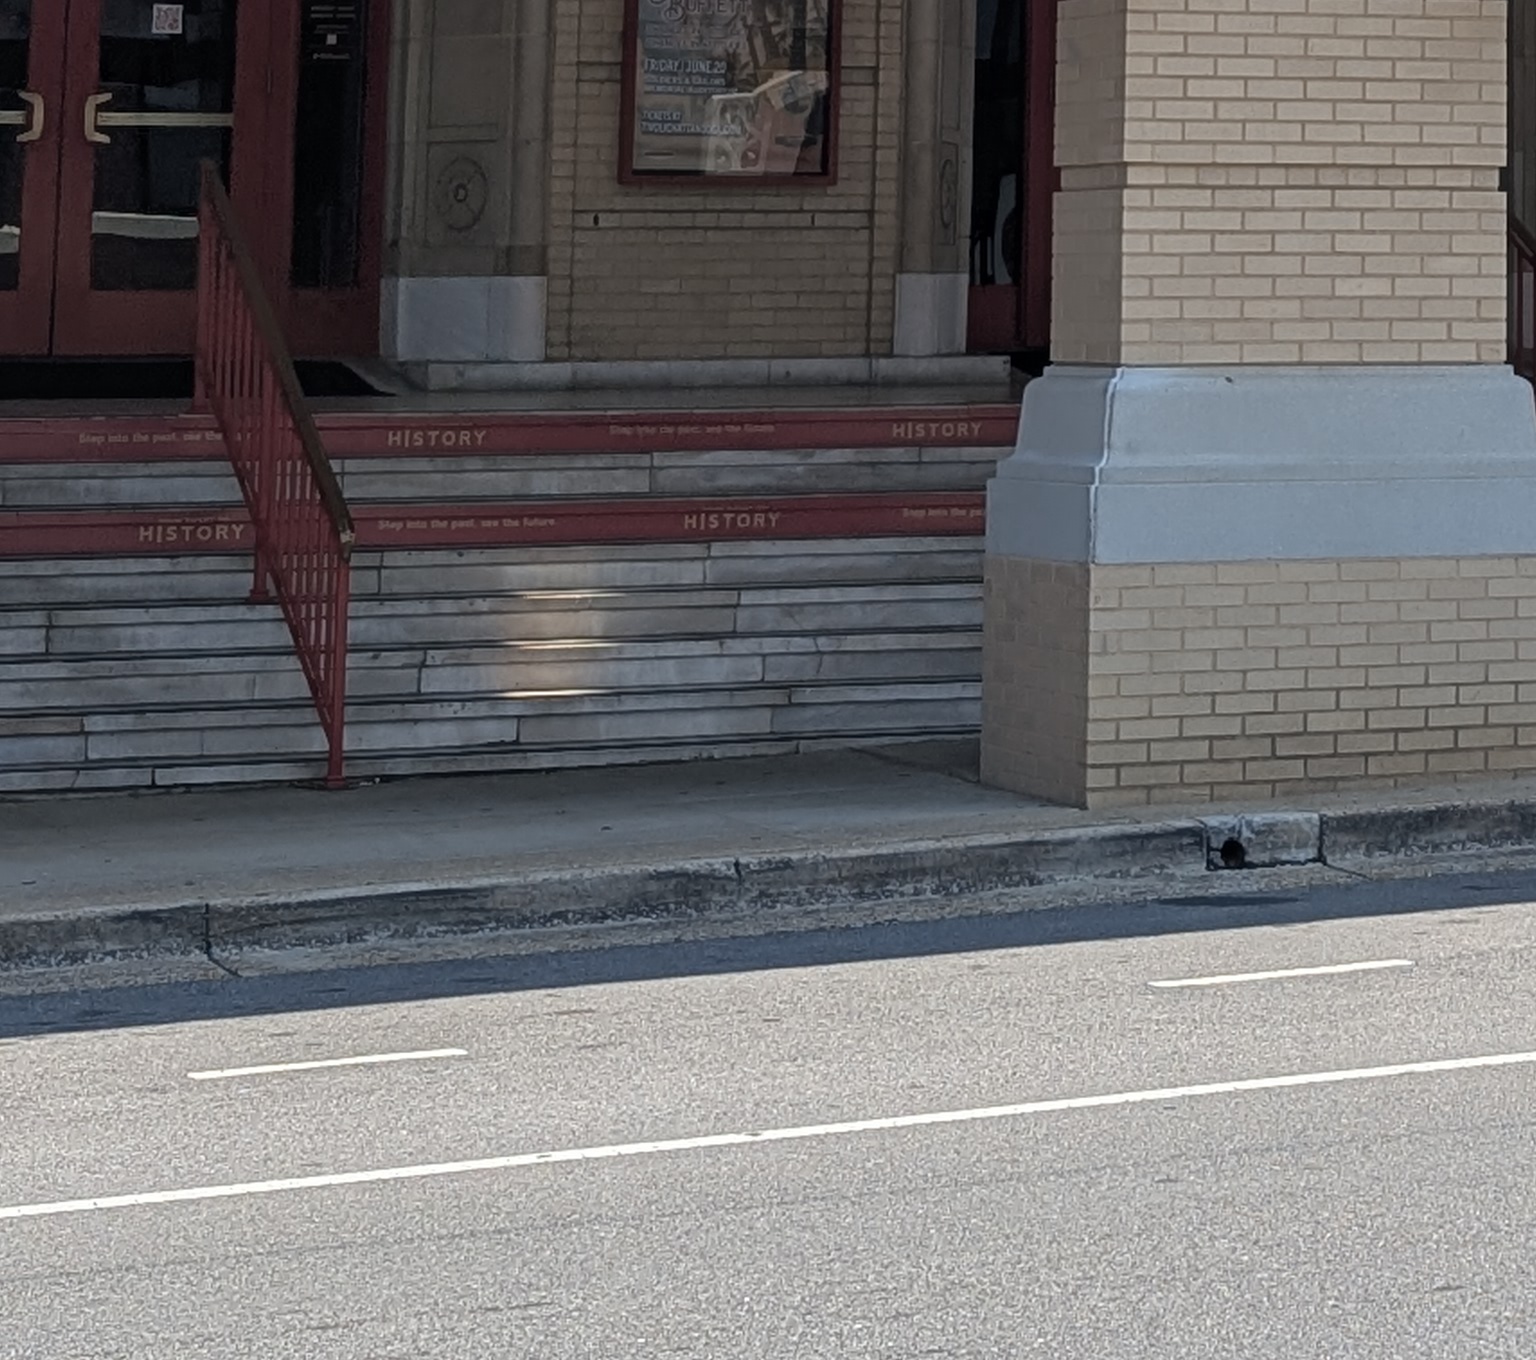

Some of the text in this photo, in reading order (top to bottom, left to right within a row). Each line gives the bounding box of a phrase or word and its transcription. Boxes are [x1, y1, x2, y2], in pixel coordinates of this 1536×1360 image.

[387, 430, 487, 448] HISTORY
[891, 421, 983, 439] HISTORY
[683, 511, 781, 530] HISTORY
[138, 523, 246, 543] HISTORY
